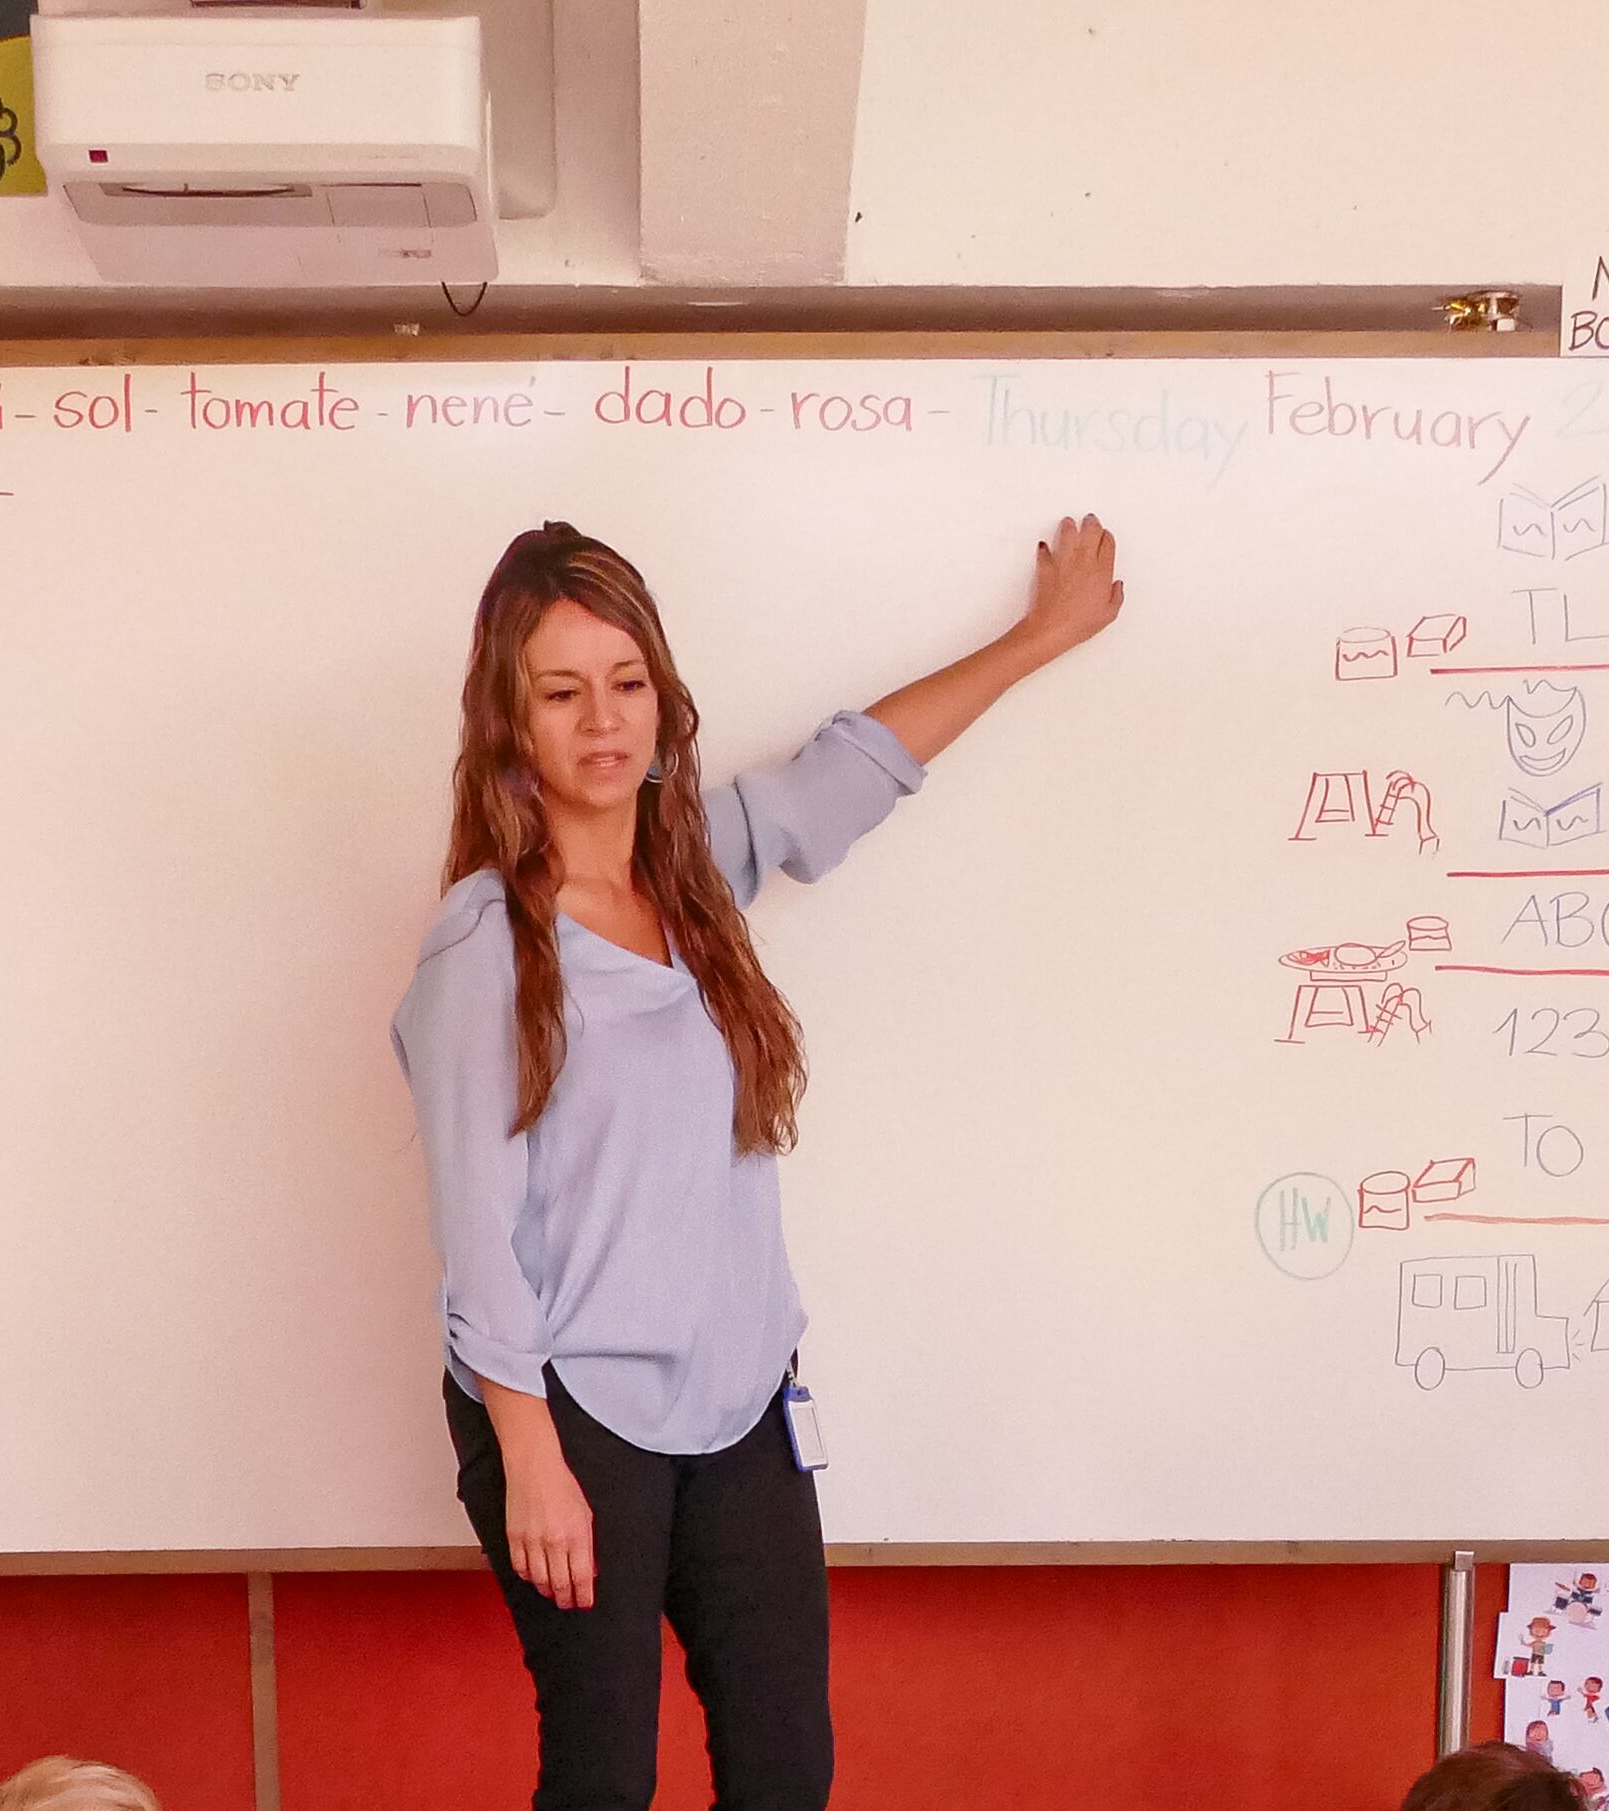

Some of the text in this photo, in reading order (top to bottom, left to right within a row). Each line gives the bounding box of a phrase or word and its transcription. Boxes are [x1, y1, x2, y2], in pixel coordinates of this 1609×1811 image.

[205, 72, 300, 92] SONY
[181, 371, 359, 430] tomate
[406, 375, 536, 430] nené
[595, 366, 746, 430] dado
[790, 388, 913, 432] rosa
[969, 374, 1251, 490] Thursday
[1263, 369, 1532, 486] February
[1512, 588, 1609, 645] TL
[1503, 1114, 1582, 1177] TO
[1279, 1188, 1334, 1252] HW
